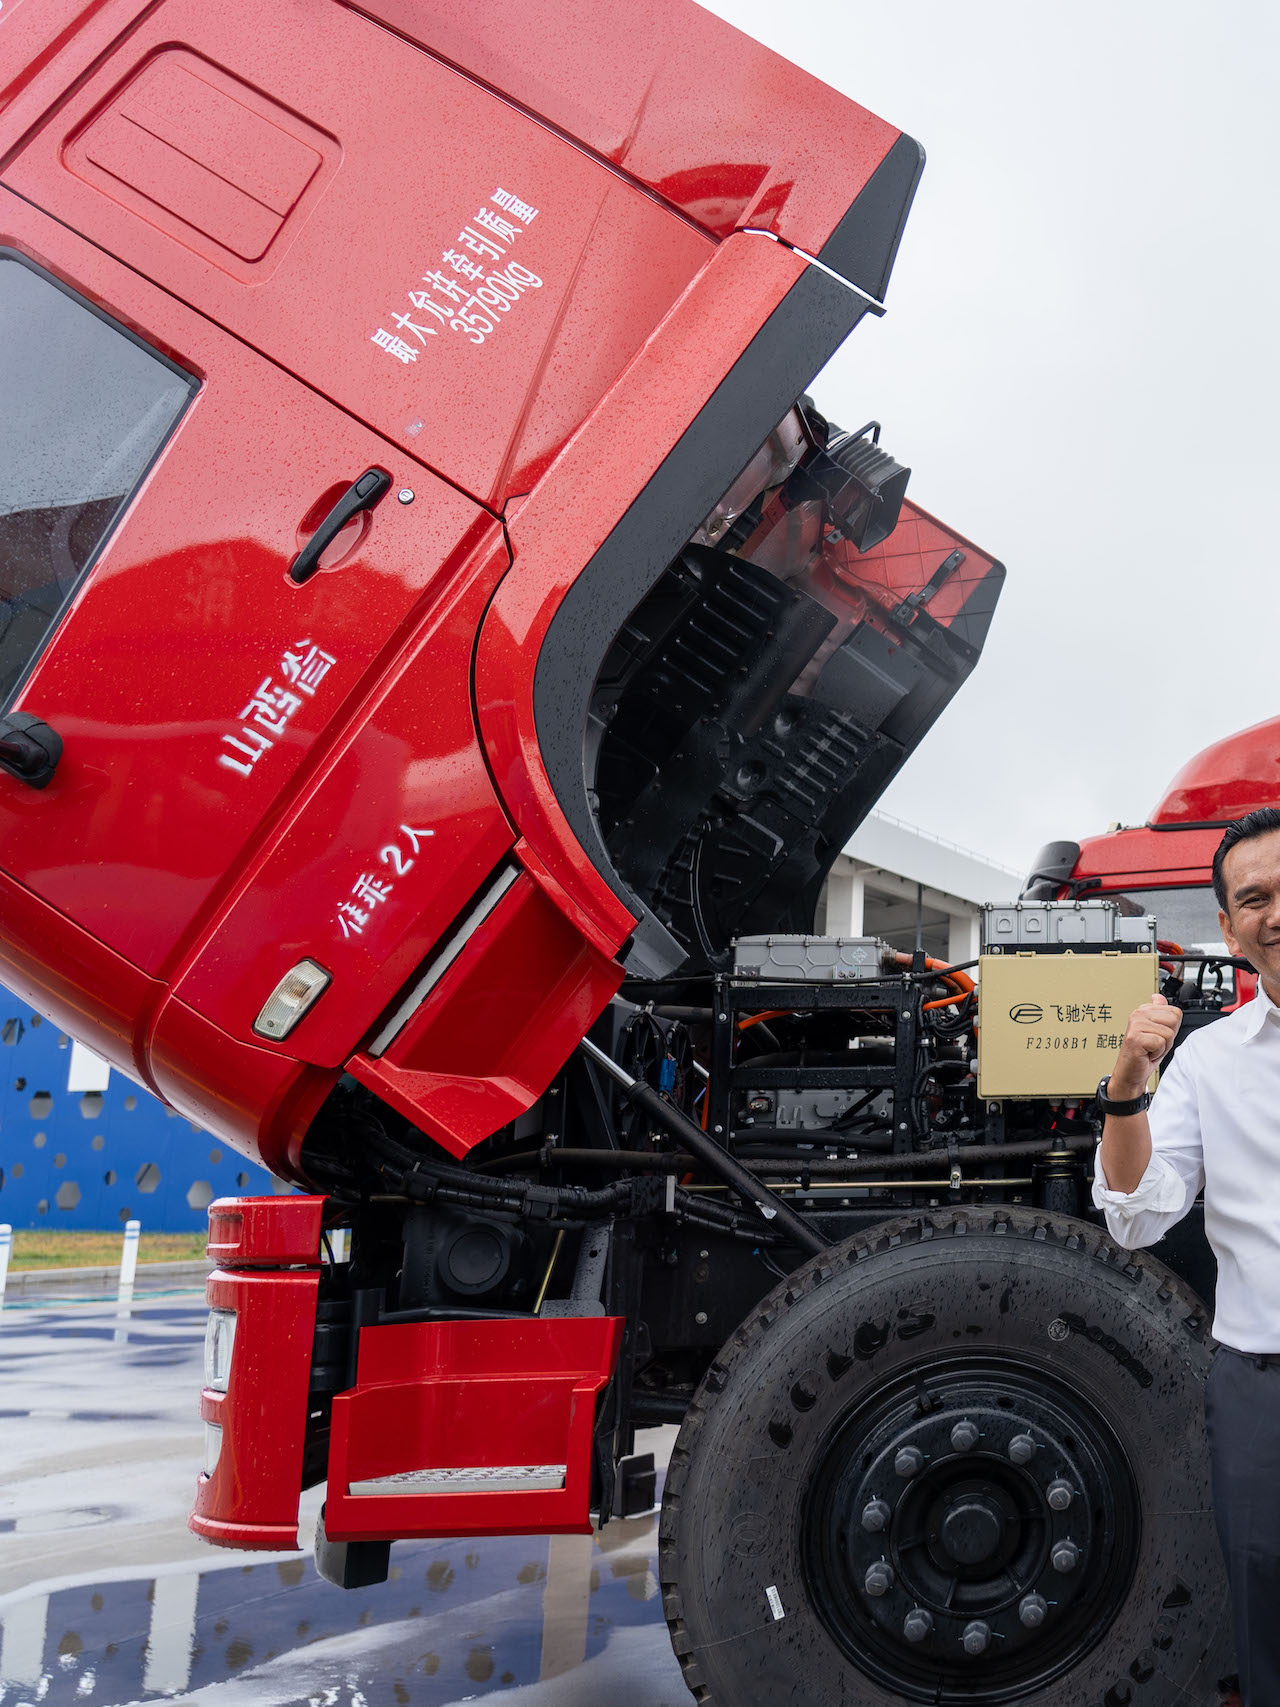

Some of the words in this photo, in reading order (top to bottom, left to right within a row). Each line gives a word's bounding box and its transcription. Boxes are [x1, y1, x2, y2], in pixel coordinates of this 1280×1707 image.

[370, 187, 540, 364] 最大允许牵引质量
[450, 261, 543, 344] 35790kg
[218, 638, 337, 777] 山西省
[1026, 1037, 1088, 1049] F2308B1
[1050, 1004, 1112, 1023] 飞驰汽车
